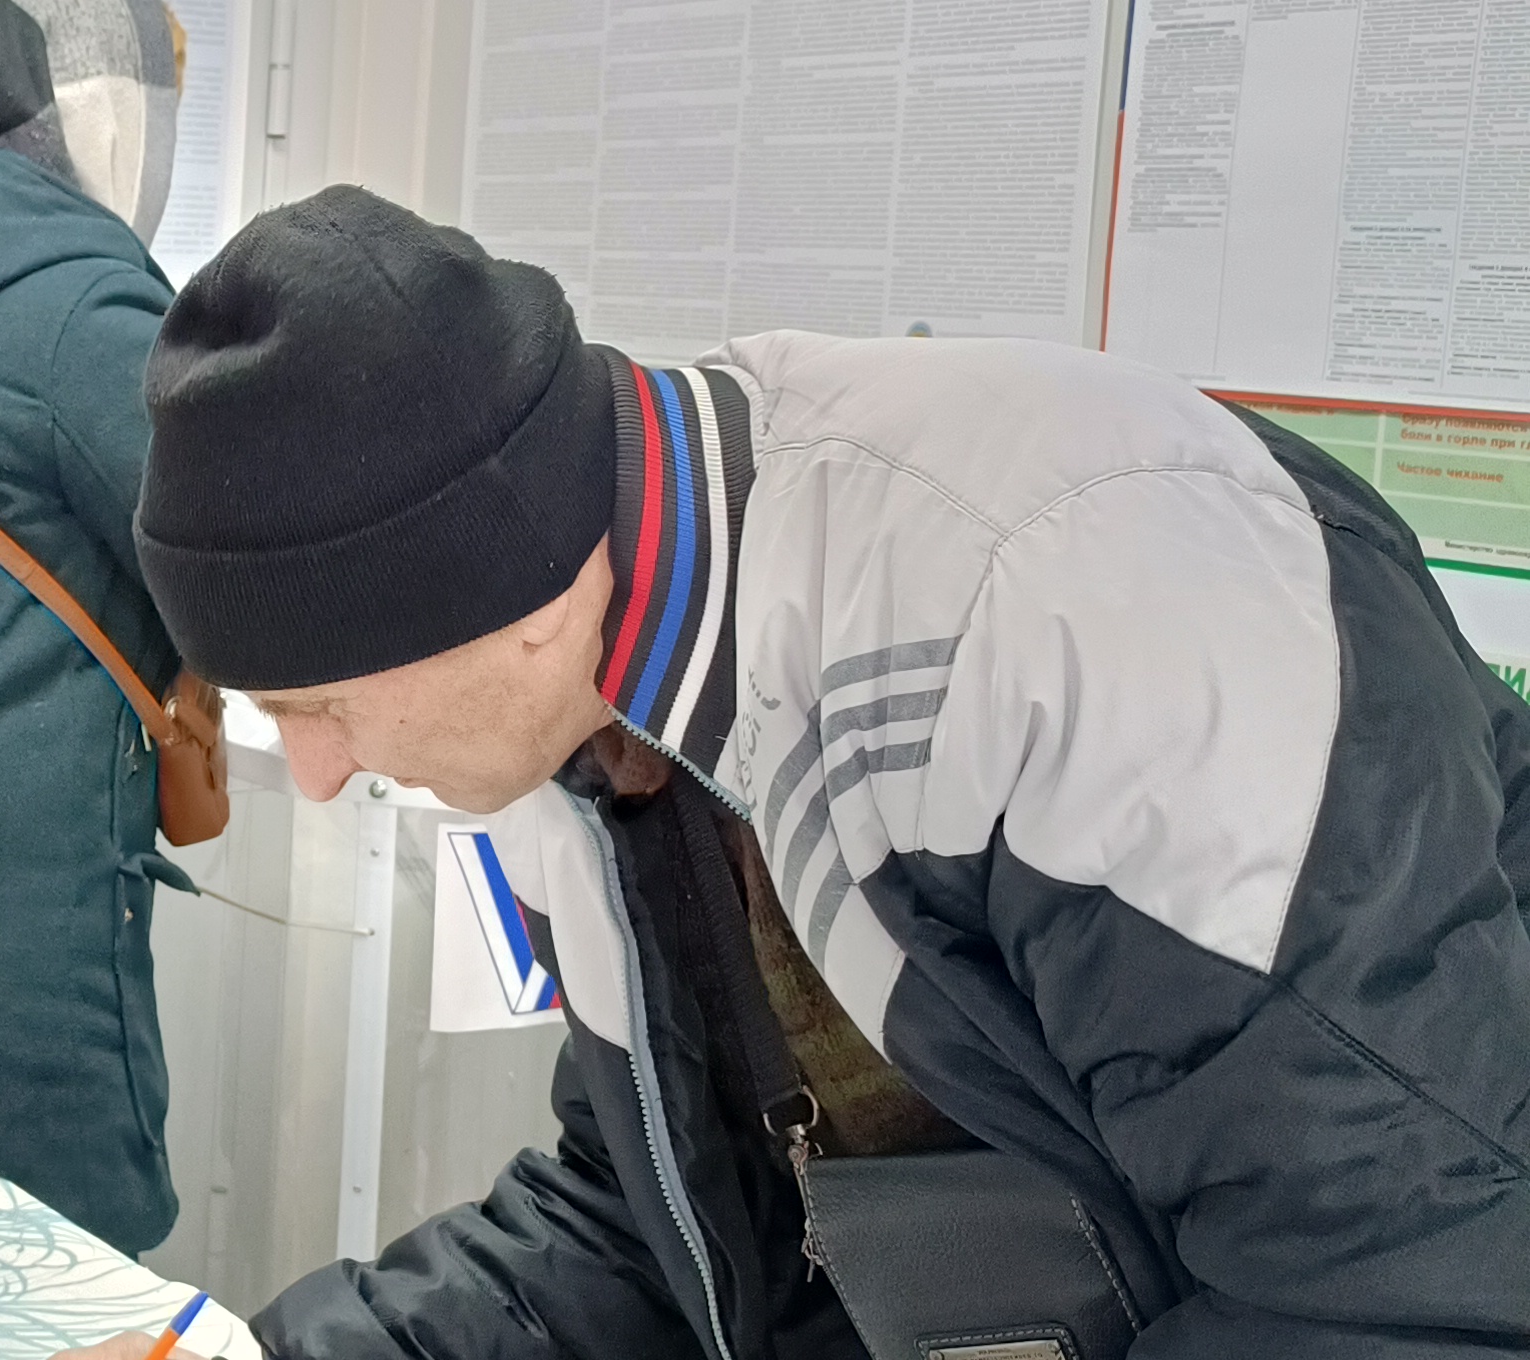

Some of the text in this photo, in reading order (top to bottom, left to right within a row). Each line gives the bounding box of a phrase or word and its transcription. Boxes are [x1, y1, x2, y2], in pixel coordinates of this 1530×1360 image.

[1400, 428, 1432, 441] боли
[1436, 434, 1443, 443] в
[1490, 438, 1516, 450] при
[1397, 461, 1504, 484] Частое чихание
